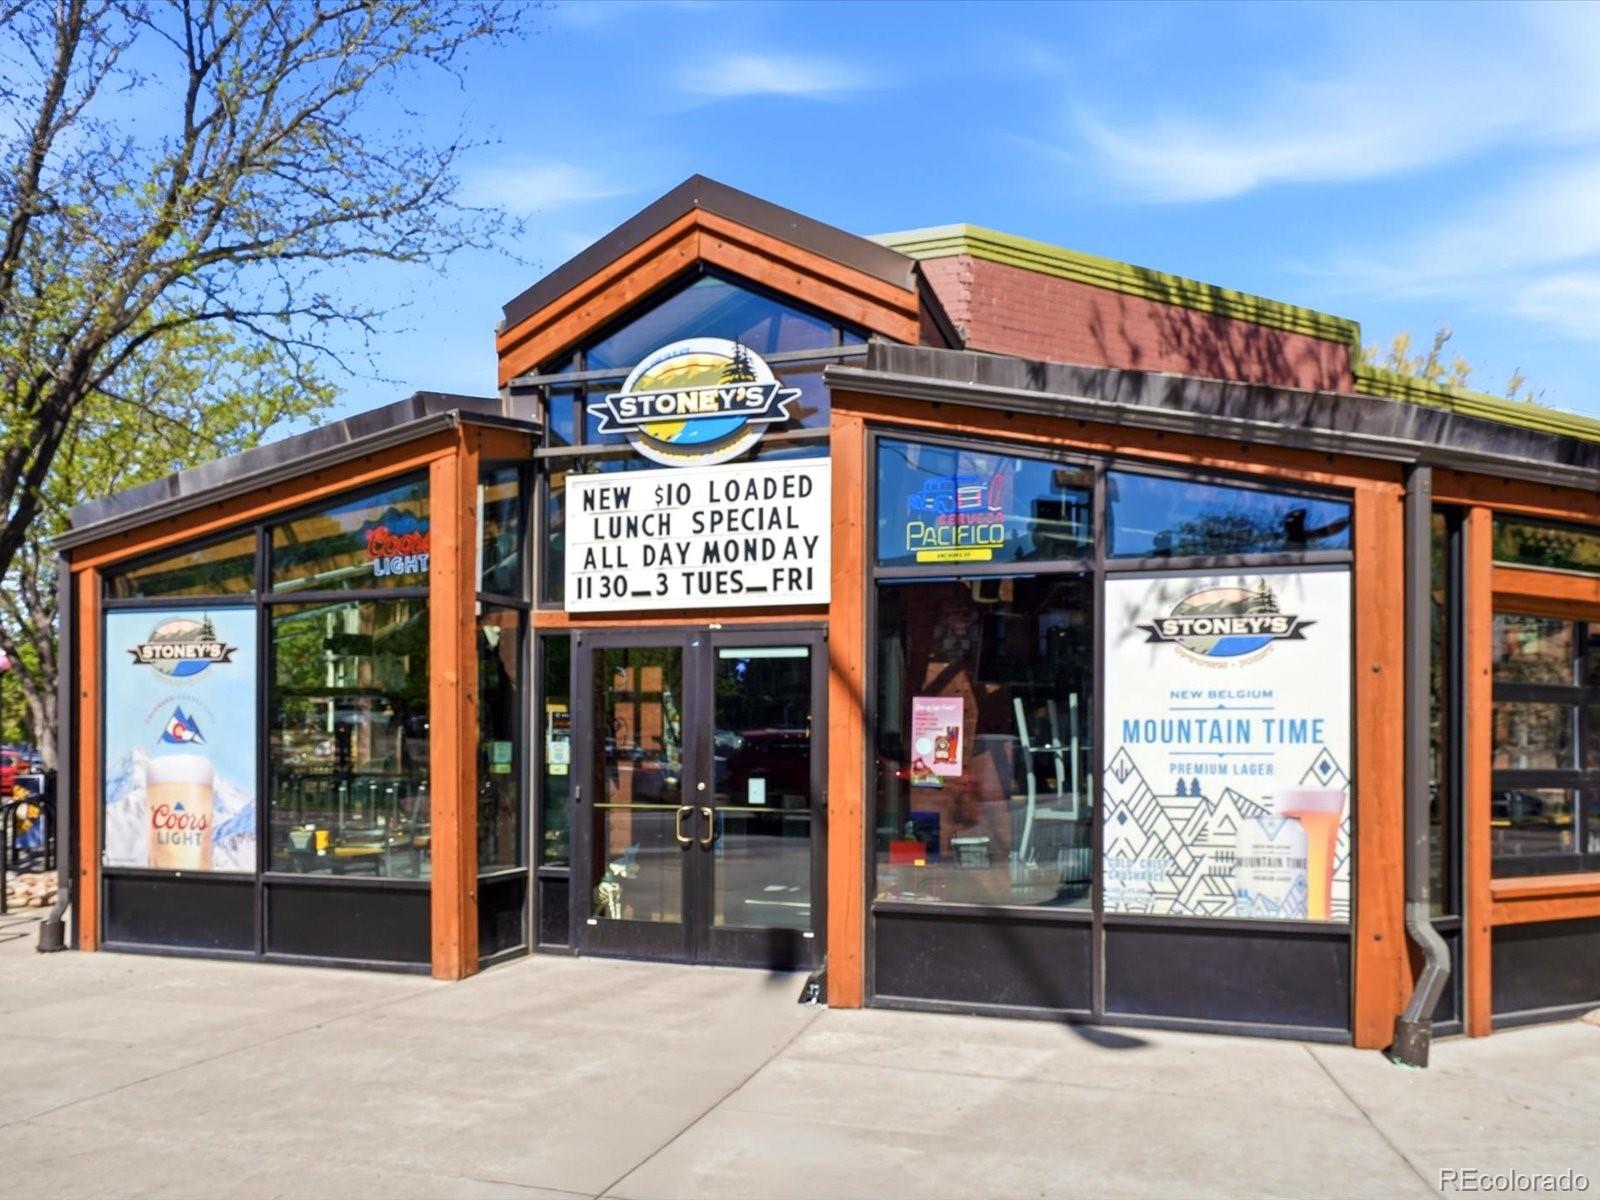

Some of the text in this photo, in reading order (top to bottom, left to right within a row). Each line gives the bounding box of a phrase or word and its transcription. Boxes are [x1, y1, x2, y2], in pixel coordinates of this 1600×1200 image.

[619, 385, 765, 418] STONEY'S
[583, 474, 813, 511] NEW $10 LOADED
[594, 506, 799, 540] LUNCH SPECIAL
[583, 535, 819, 570] ALL DAY MONDAY
[373, 553, 430, 577] LIGHT
[1162, 616, 1289, 636] STONEY'S
[142, 644, 222, 661] STONEY'S
[1170, 690, 1274, 699] NEW BELGIUM
[1122, 719, 1325, 744] MOUNTAIN TIME
[1169, 763, 1274, 776] PREMIUM LAGER
[151, 804, 208, 831] Coors
[157, 831, 202, 846] LIGHT
